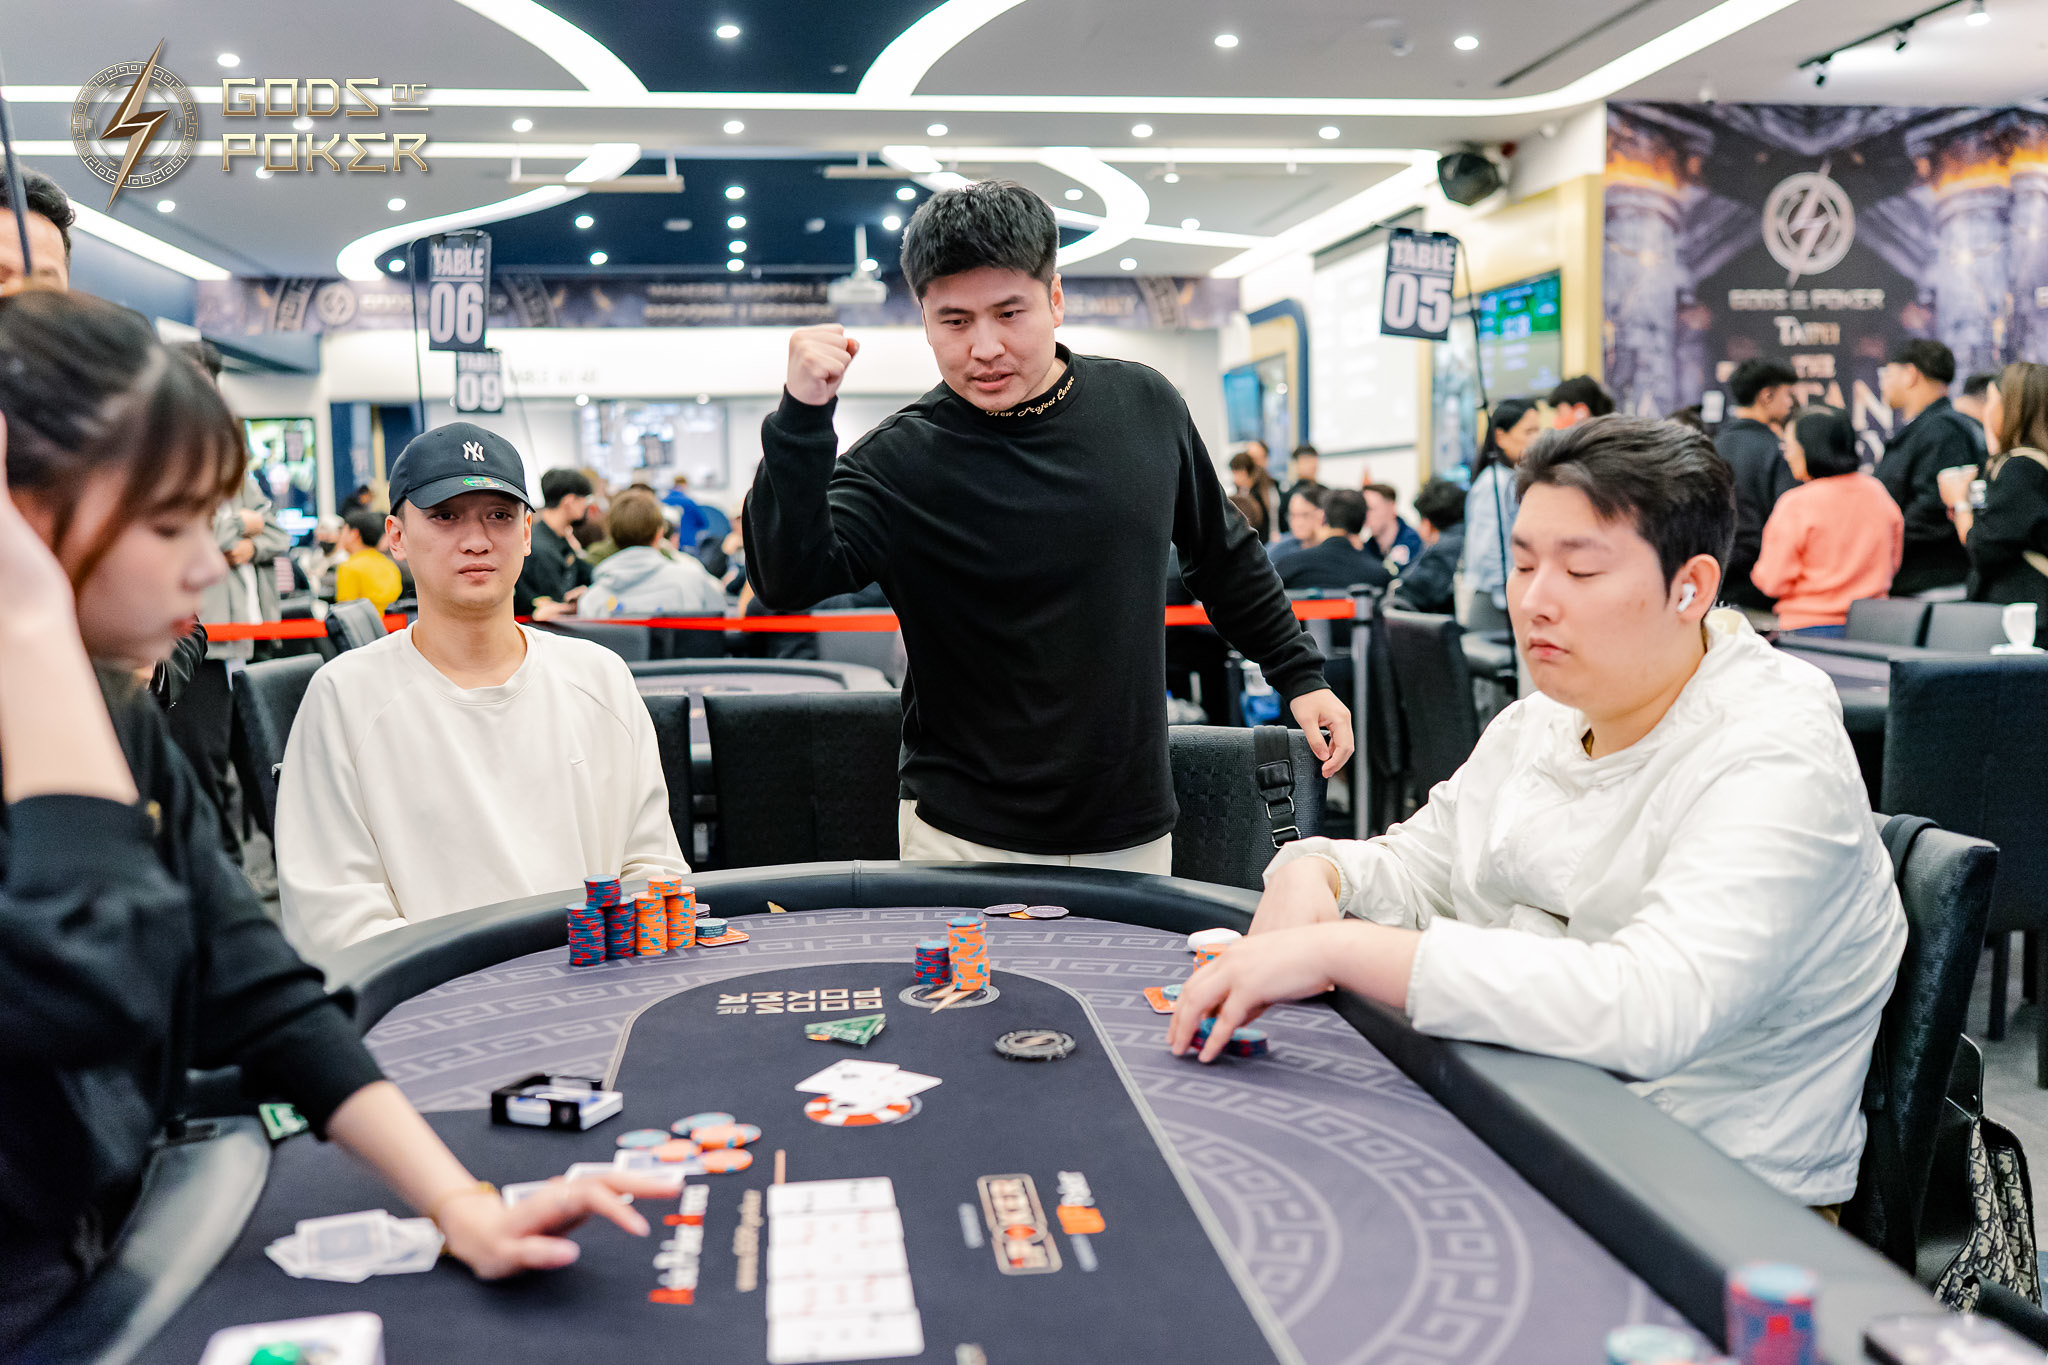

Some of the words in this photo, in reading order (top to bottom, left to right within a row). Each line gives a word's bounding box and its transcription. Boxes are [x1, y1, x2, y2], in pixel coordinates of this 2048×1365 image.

[432, 247, 485, 277] TABLE
[1390, 237, 1456, 272] TABLE
[430, 282, 484, 344] 06
[1384, 272, 1453, 334] 05
[457, 373, 502, 412] 09
[462, 440, 485, 462] NY
